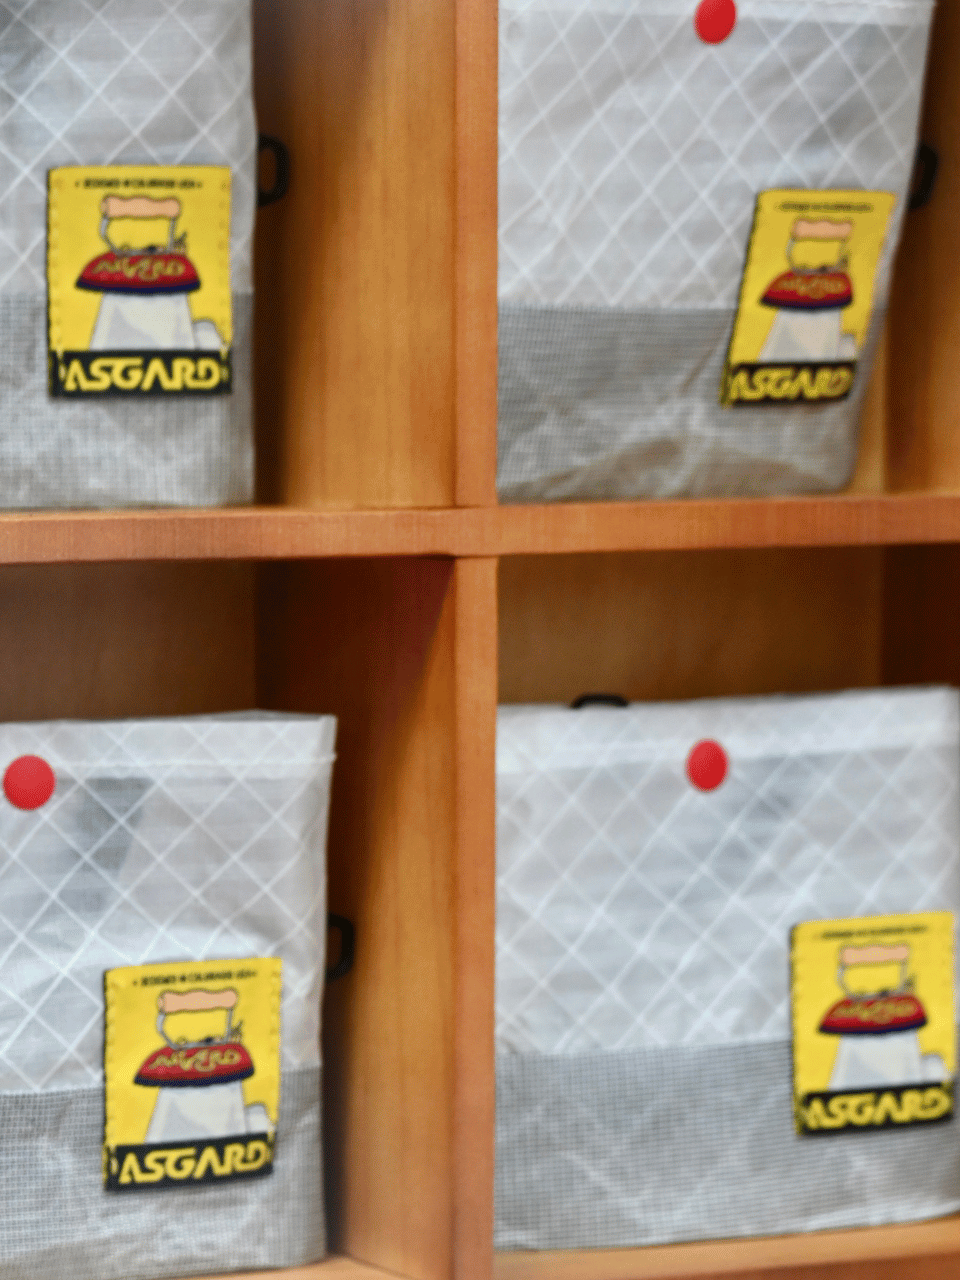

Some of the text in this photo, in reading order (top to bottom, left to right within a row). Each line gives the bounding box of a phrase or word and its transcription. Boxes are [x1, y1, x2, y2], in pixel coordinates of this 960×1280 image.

[64, 357, 221, 391] ASGARD
[730, 367, 854, 399] ASGARD
[804, 1088, 951, 1129] ASGARD
[119, 1140, 269, 1184] ASGARD
